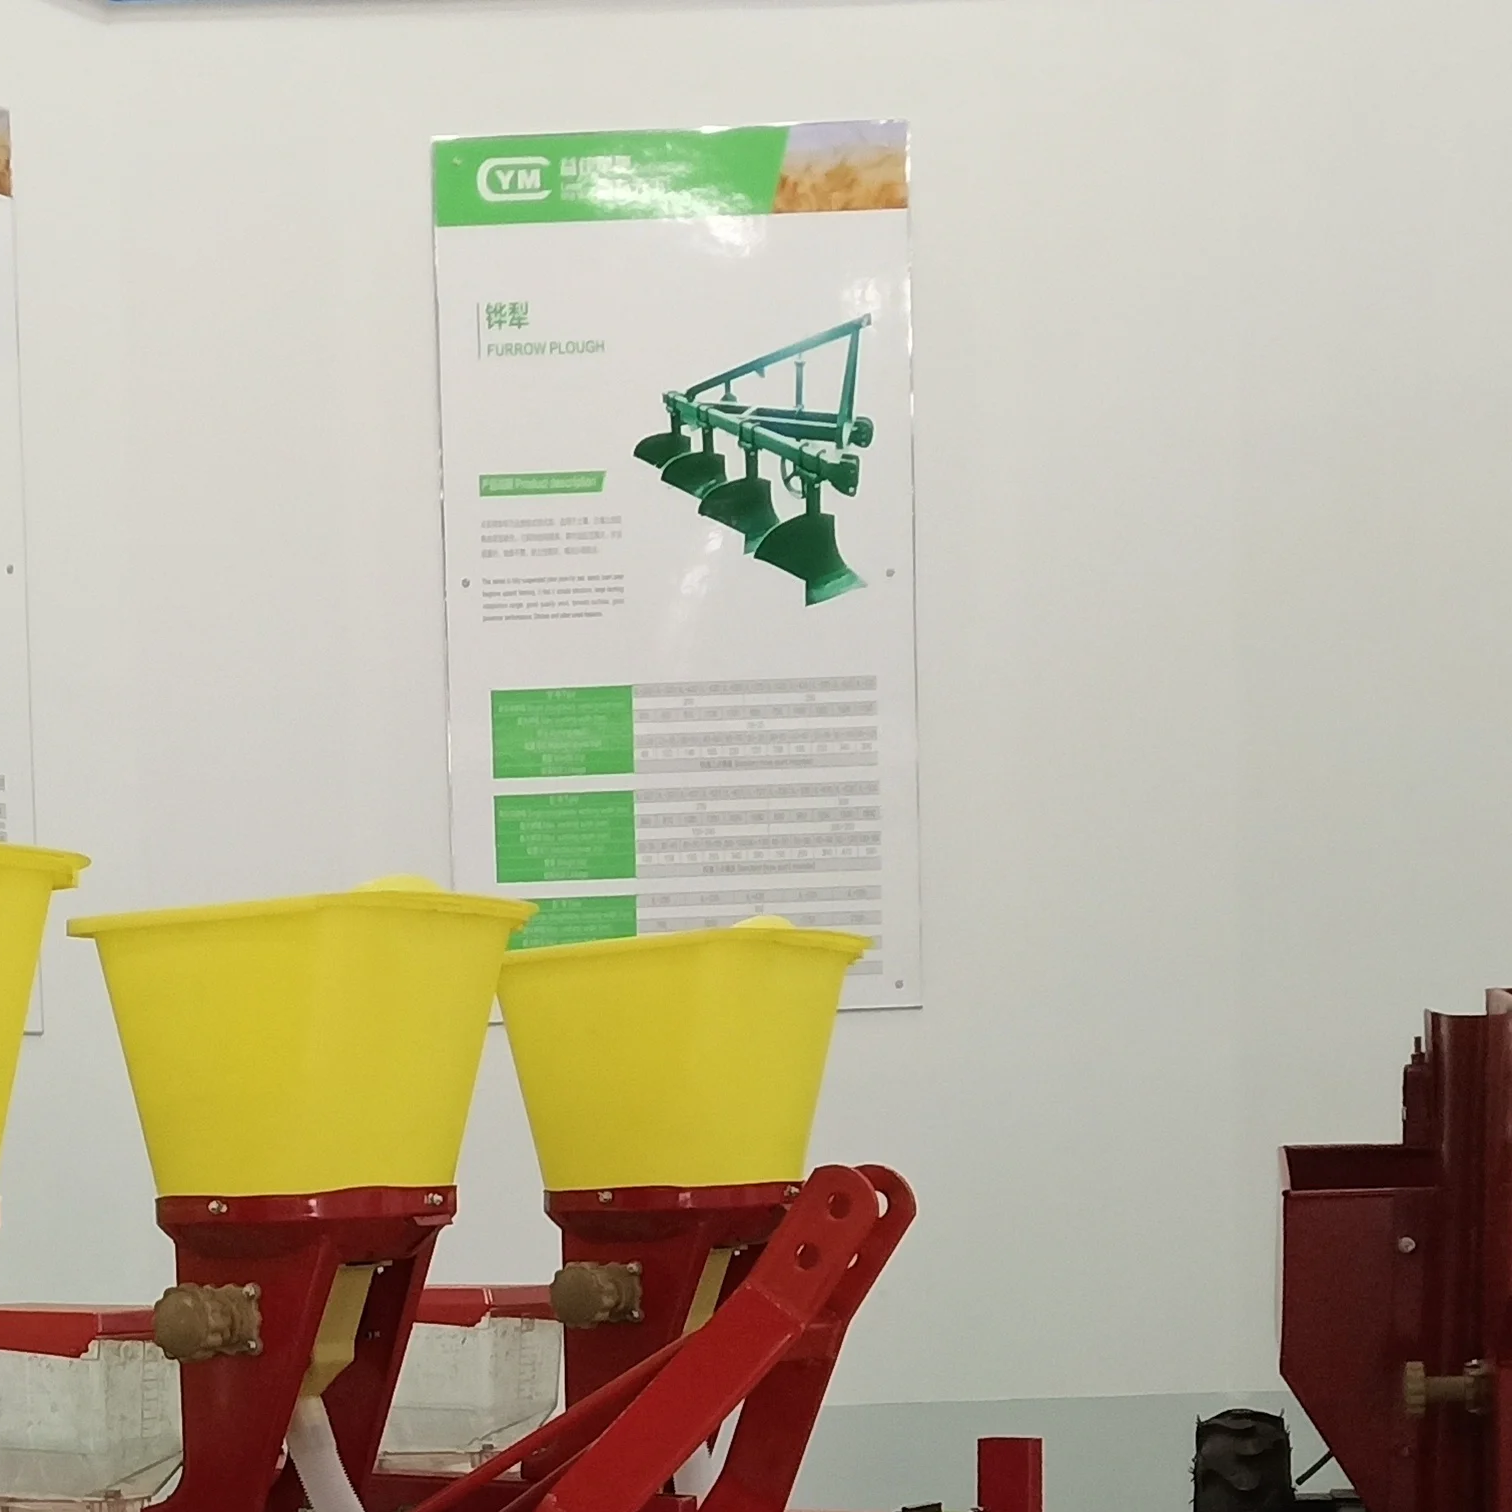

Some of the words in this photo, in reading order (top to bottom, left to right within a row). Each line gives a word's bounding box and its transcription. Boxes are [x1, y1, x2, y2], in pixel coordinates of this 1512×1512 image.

[485, 301, 529, 329] 铧犁
[487, 342, 547, 357] FURROW
[549, 340, 605, 355] PLOUGH
